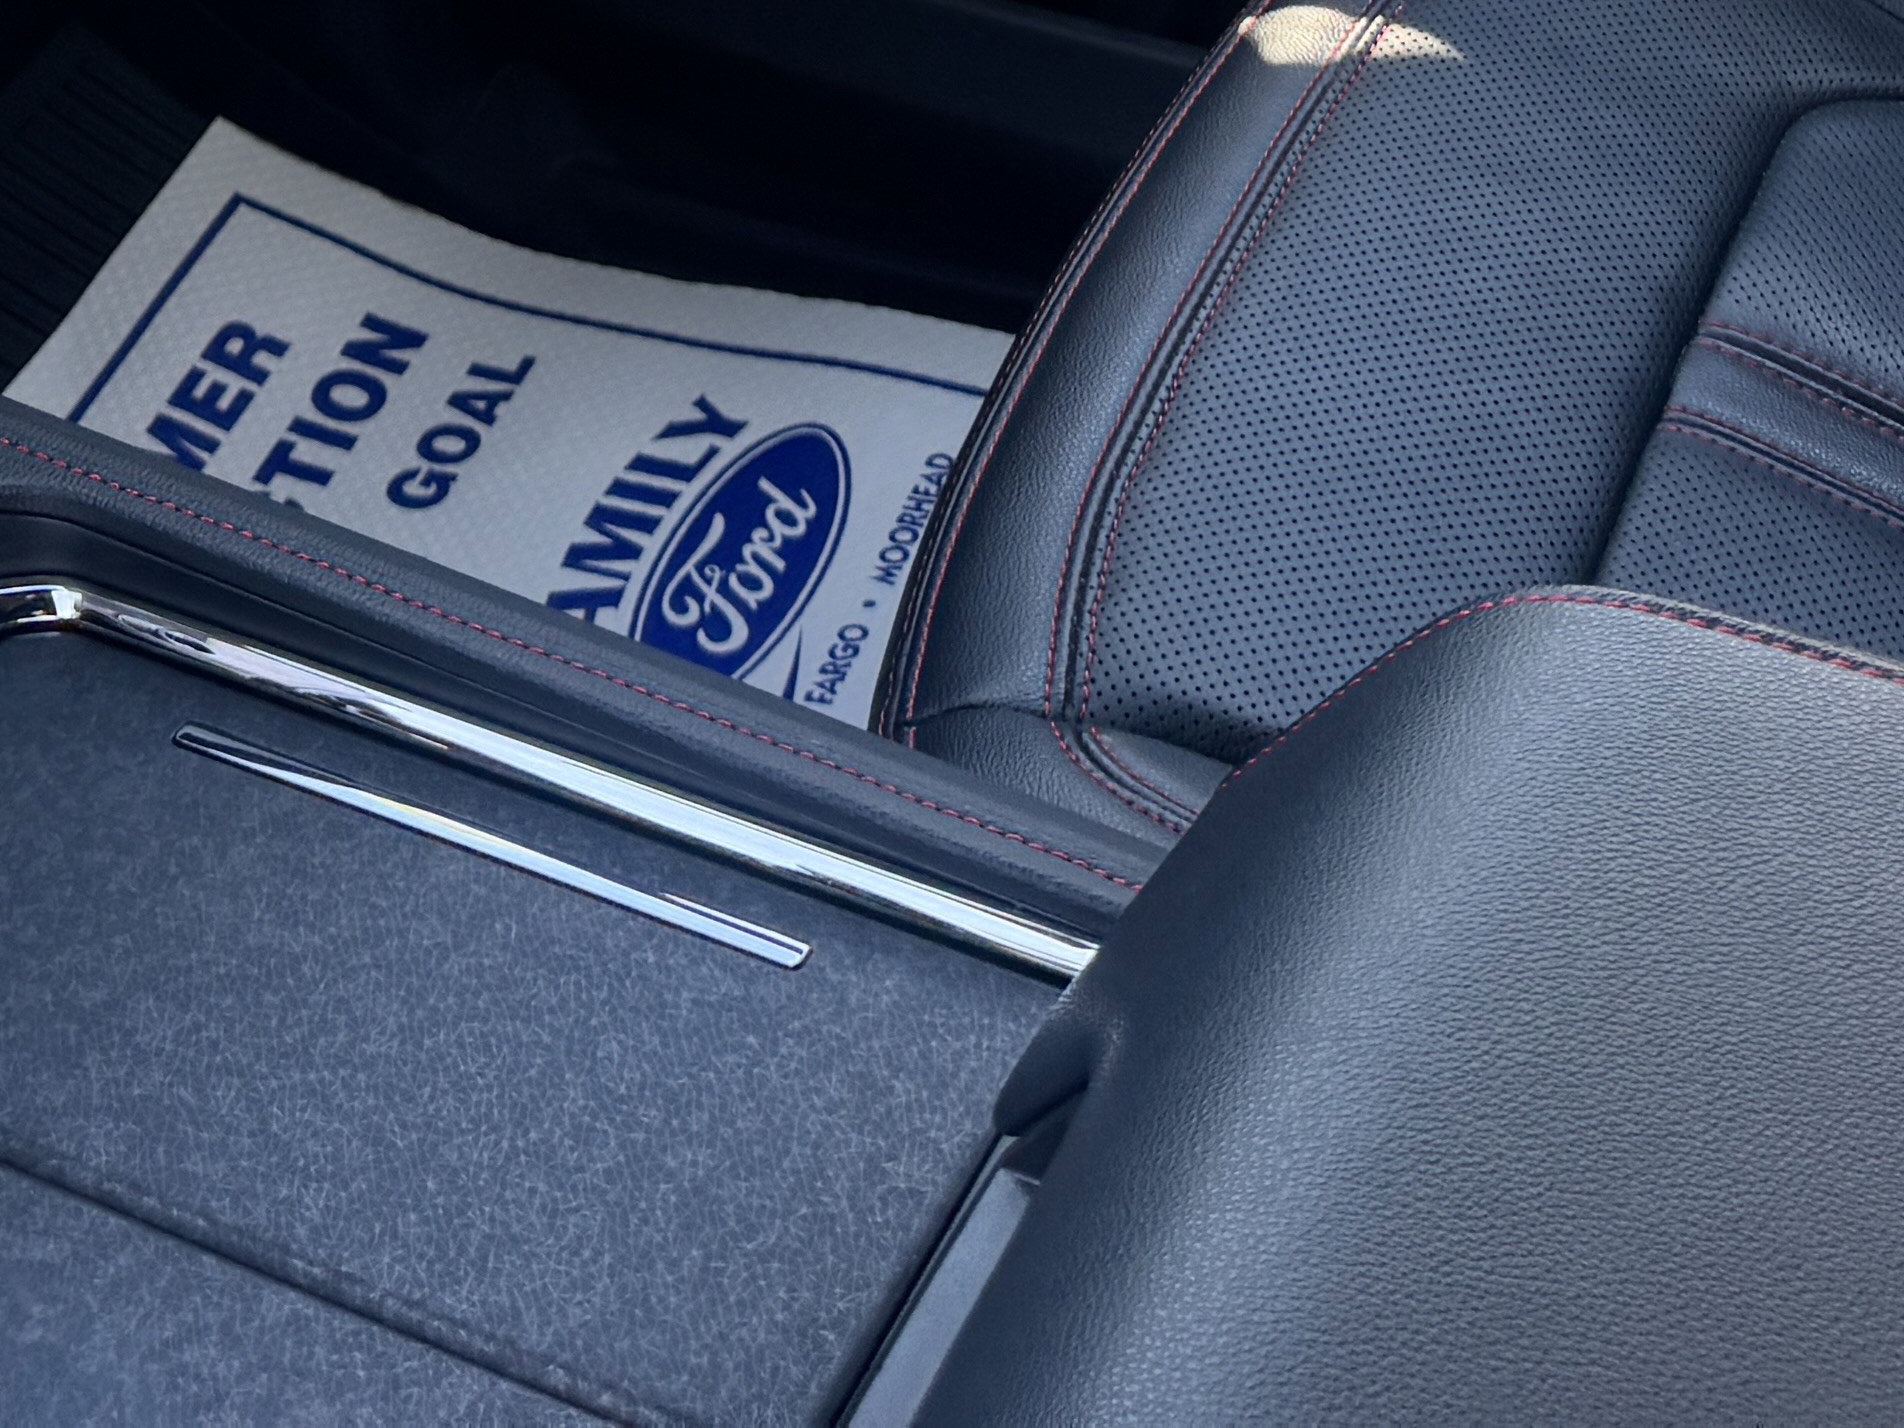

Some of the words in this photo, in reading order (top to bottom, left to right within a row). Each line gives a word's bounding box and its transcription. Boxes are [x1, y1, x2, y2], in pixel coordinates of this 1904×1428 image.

[252, 310, 429, 510] TION
[386, 355, 537, 510] GOAL
[547, 394, 750, 624] AMILY
[662, 476, 817, 656] Ford
[804, 622, 871, 706] FARGO
[875, 452, 954, 586] MOORHEAD
